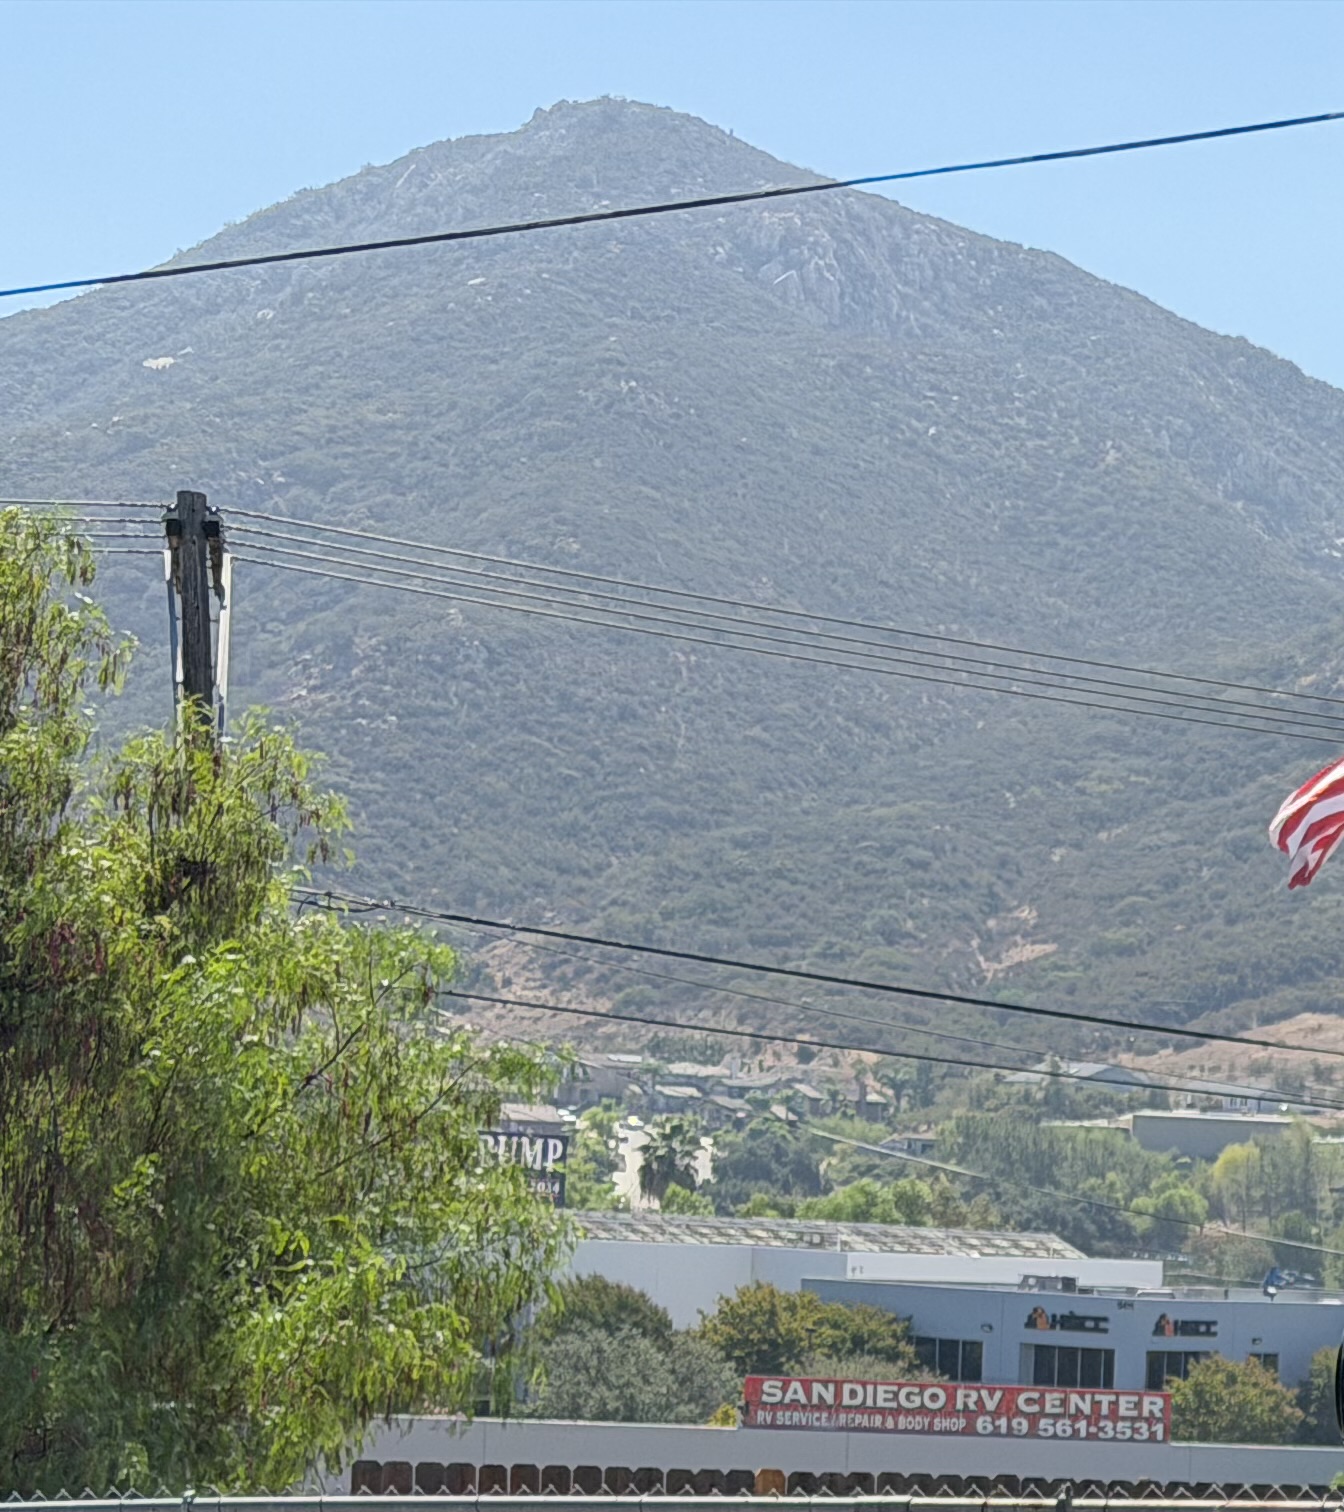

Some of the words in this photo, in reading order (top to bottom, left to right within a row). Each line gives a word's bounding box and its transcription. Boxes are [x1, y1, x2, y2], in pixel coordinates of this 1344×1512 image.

[478, 1134, 563, 1171] RUMP
[761, 1380, 836, 1405] SAN
[842, 1382, 947, 1410] DIEGO
[955, 1388, 1003, 1412] RV
[1017, 1391, 1164, 1418] CENTER
[757, 1411, 772, 1425] RV
[776, 1411, 828, 1428] SERVICE
[840, 1413, 882, 1429] REPAIR
[897, 1415, 929, 1431] BODY
[933, 1417, 967, 1432] SHOP
[976, 1415, 1029, 1436] 619
[1037, 1418, 1164, 1441] 561-3531
